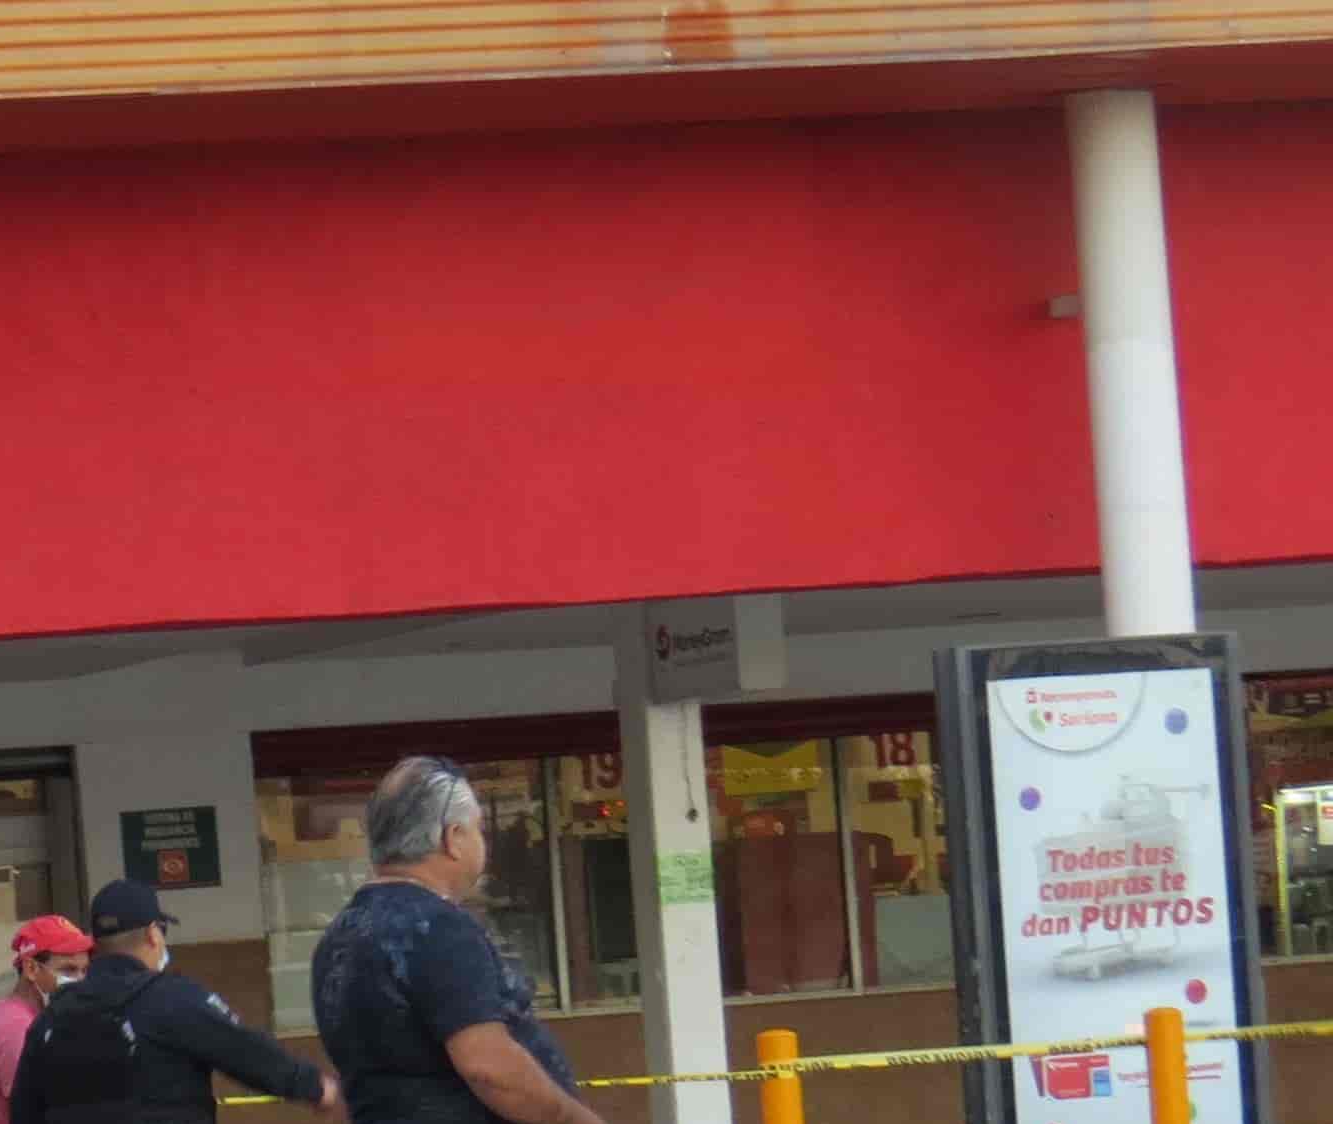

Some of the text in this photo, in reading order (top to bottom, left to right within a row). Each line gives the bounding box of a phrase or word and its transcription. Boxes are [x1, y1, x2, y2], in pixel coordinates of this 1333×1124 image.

[873, 731, 915, 768] 18
[582, 752, 623, 791] 19
[1046, 842, 1175, 873] Todas tus
[1039, 868, 1187, 904] compras te
[1021, 897, 1215, 938] dan PUNTOS
